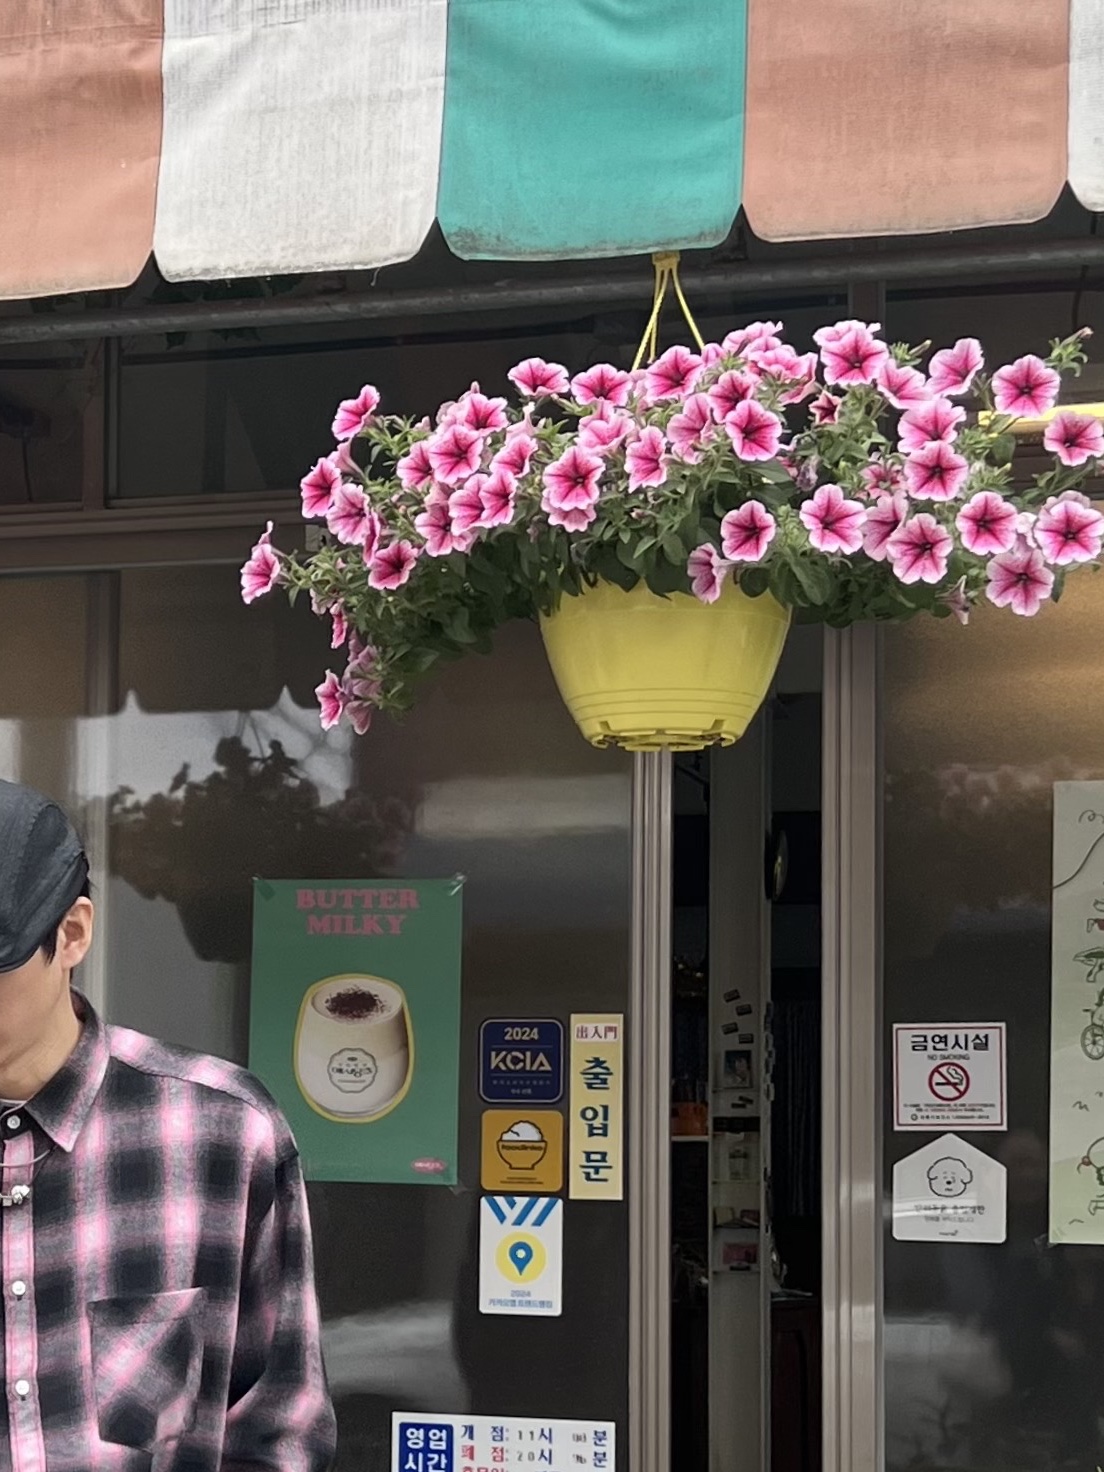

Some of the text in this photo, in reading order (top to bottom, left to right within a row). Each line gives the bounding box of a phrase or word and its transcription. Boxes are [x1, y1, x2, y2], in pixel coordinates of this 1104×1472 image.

[296, 888, 419, 910] BUTTER
[307, 915, 407, 936] MILKY
[503, 1026, 539, 1041] 2024
[576, 1025, 618, 1040] 出入門
[910, 1033, 990, 1052] 금연시설
[490, 1050, 552, 1072] KCIA
[939, 1053, 970, 1061] SMOKING
[579, 1056, 614, 1183] 출입문
[405, 1427, 448, 1450] 영업
